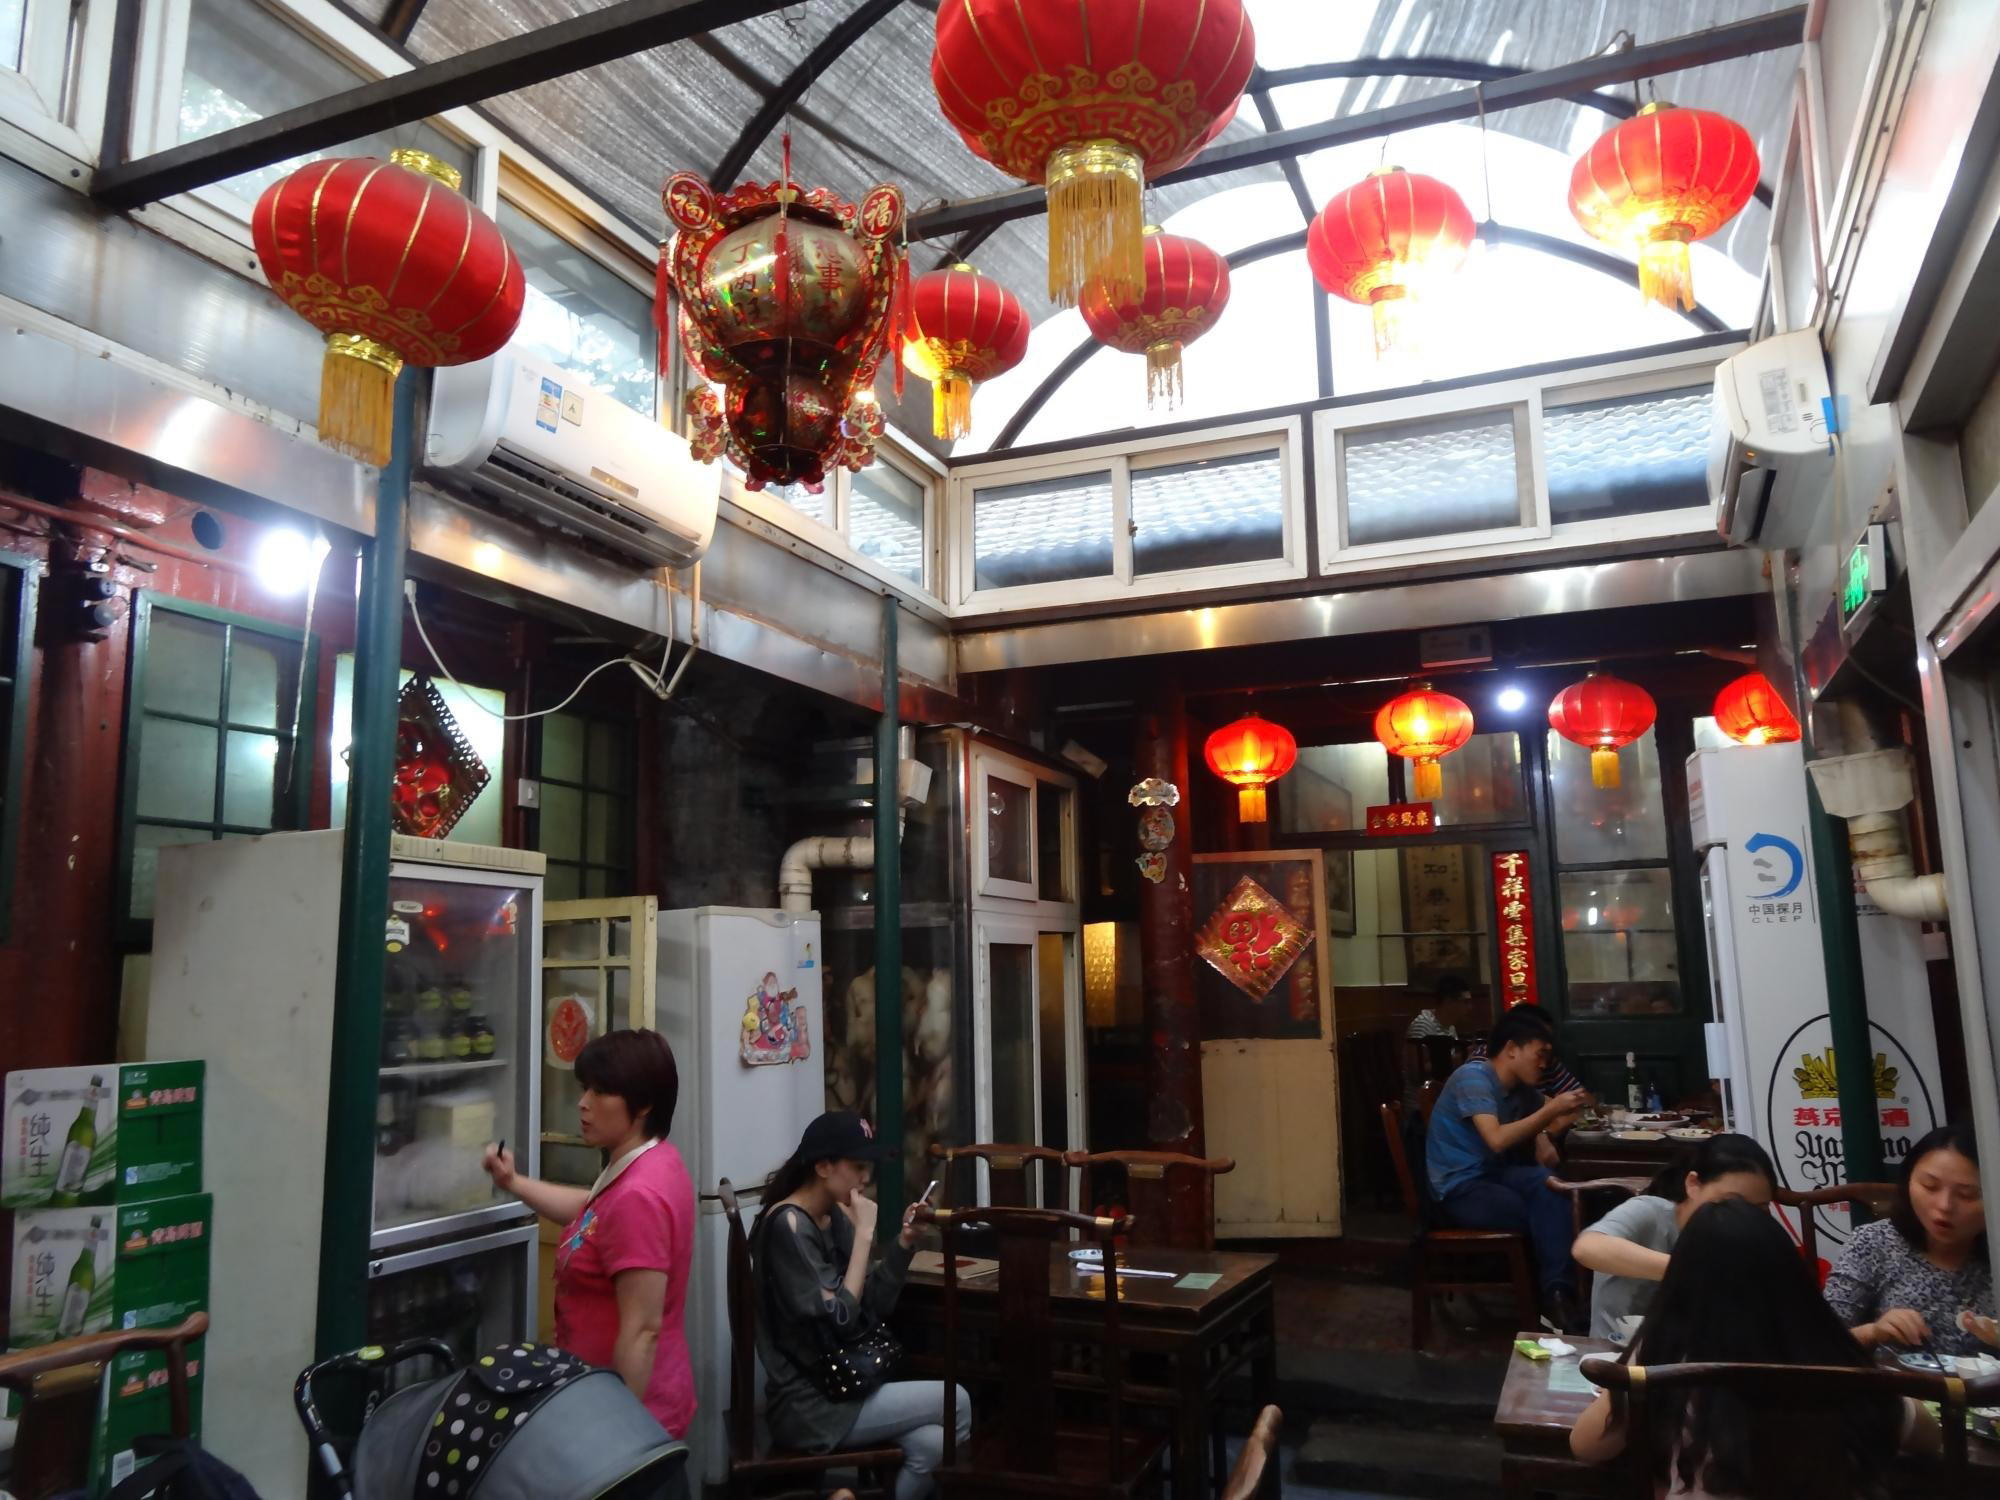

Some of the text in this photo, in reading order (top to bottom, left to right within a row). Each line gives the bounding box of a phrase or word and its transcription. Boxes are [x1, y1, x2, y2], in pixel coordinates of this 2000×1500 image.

[864, 194, 894, 231] 福
[1748, 902, 1803, 916] 中国探月
[1750, 914, 1802, 924] CLEP
[1793, 1107, 1910, 1128] 燕京酒
